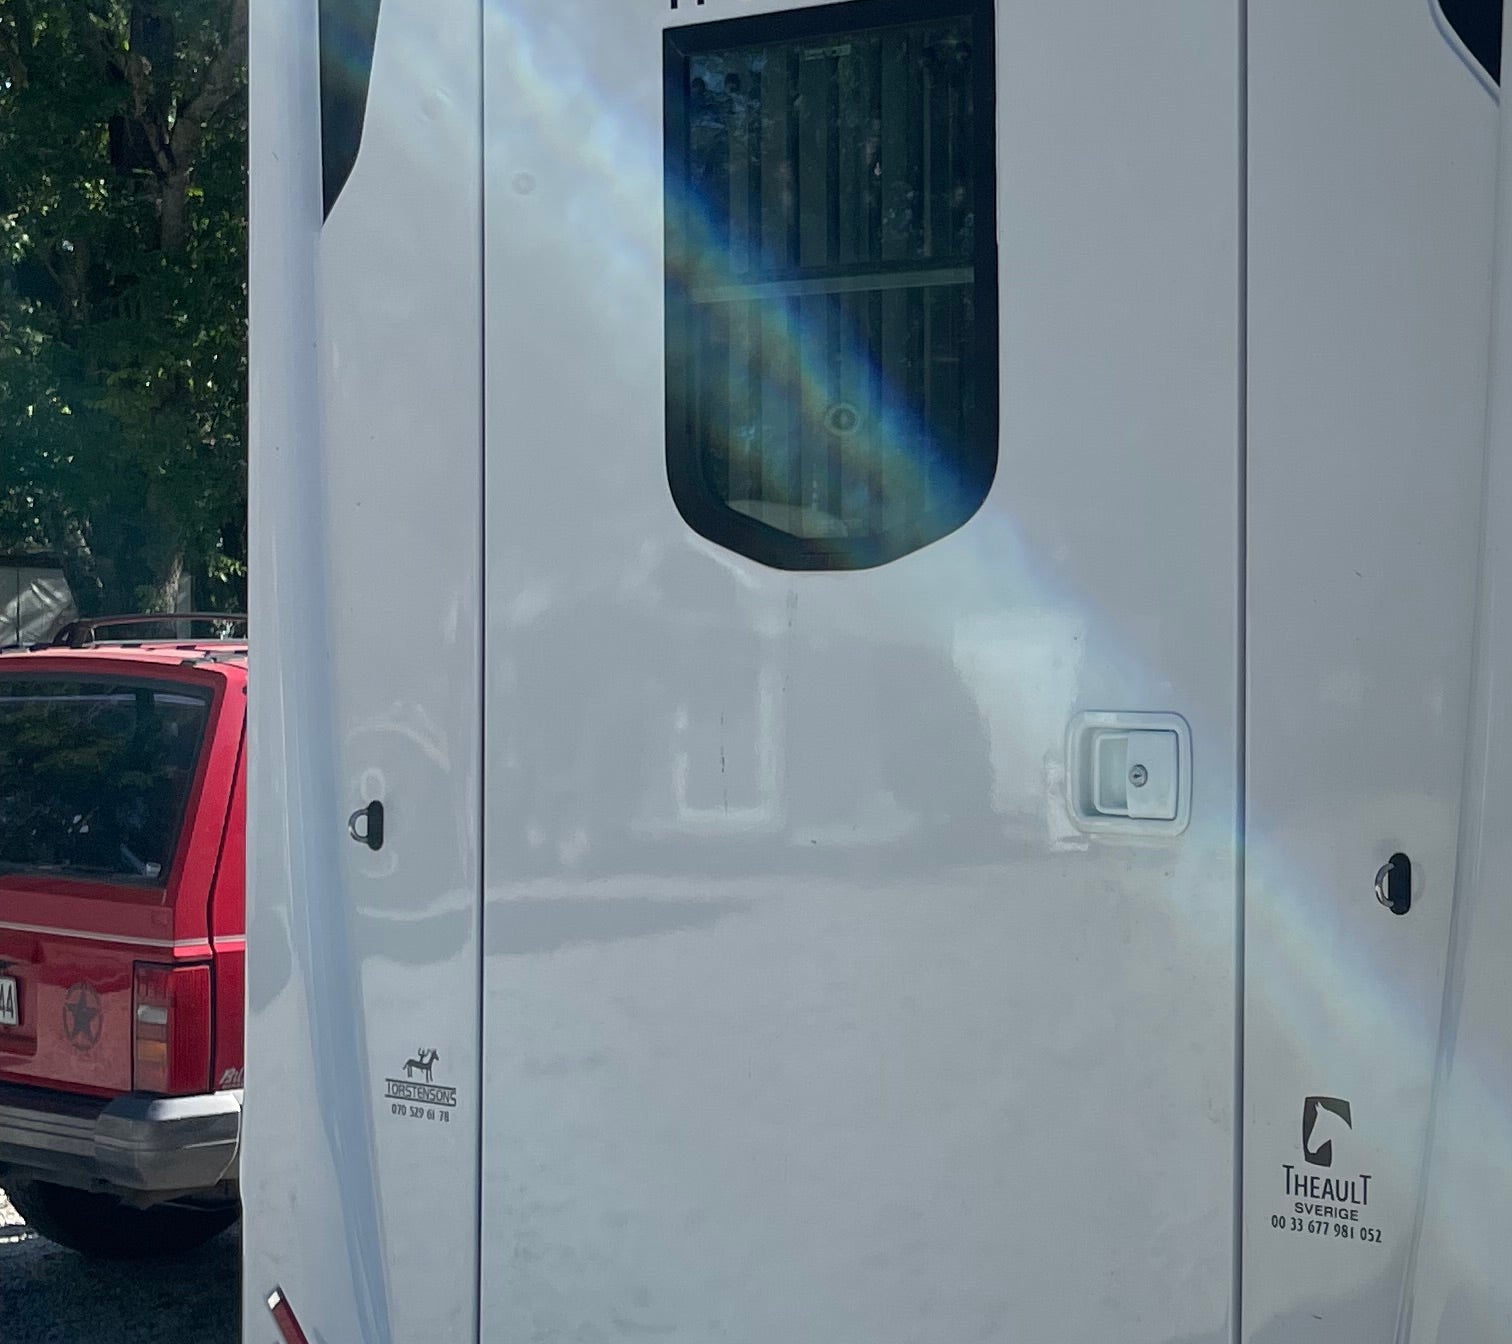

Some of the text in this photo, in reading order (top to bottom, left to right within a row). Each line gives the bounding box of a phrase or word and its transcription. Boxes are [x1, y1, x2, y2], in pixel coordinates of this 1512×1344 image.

[385, 1079, 456, 1107] TORSTENSONS
[391, 1103, 407, 1116] 070
[1282, 1164, 1372, 1205] THEAULT
[1294, 1202, 1358, 1221] SVERIGE
[1271, 1214, 1382, 1243] 00 33 677 981 052
